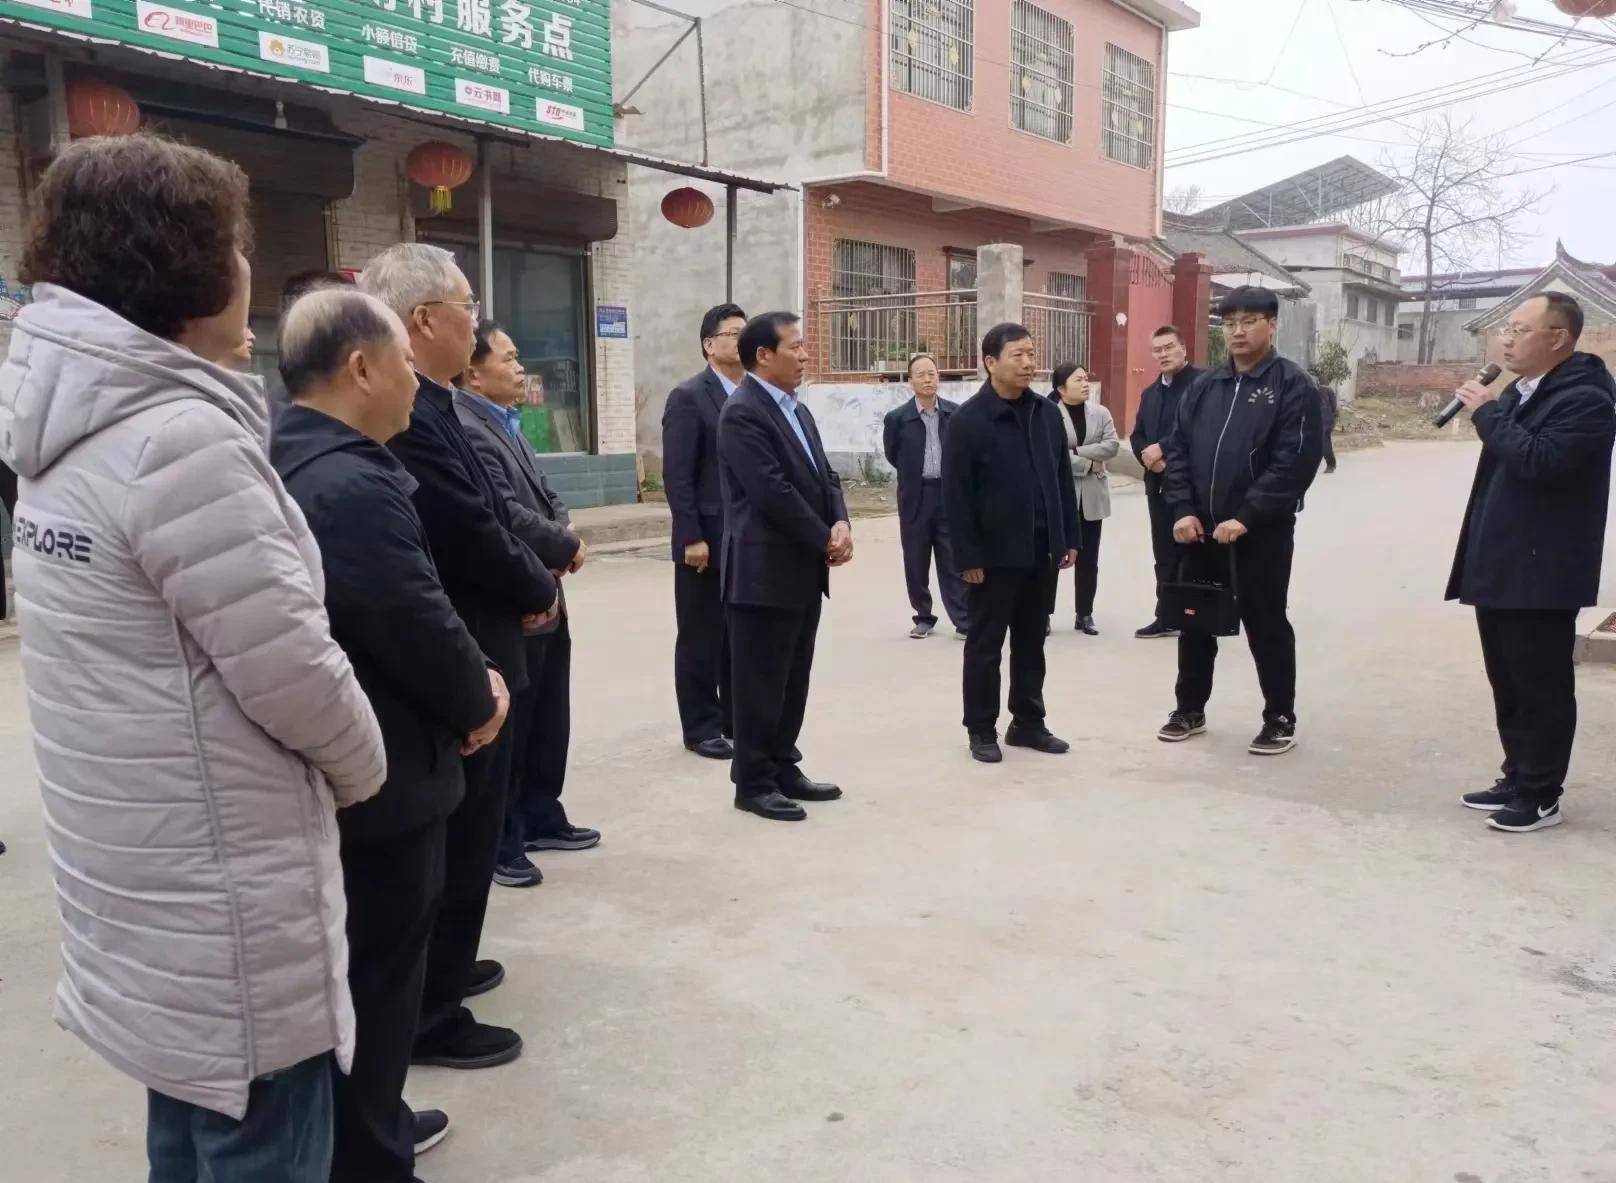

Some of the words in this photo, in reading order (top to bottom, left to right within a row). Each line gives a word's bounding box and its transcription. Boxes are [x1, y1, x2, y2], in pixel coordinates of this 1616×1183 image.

[361, 24, 417, 54] 小额信贷
[367, 0, 574, 60] 村服务点
[450, 47, 500, 74] 充值缴费
[528, 67, 574, 93] 代购车票
[16, 517, 92, 563] EPLORE
